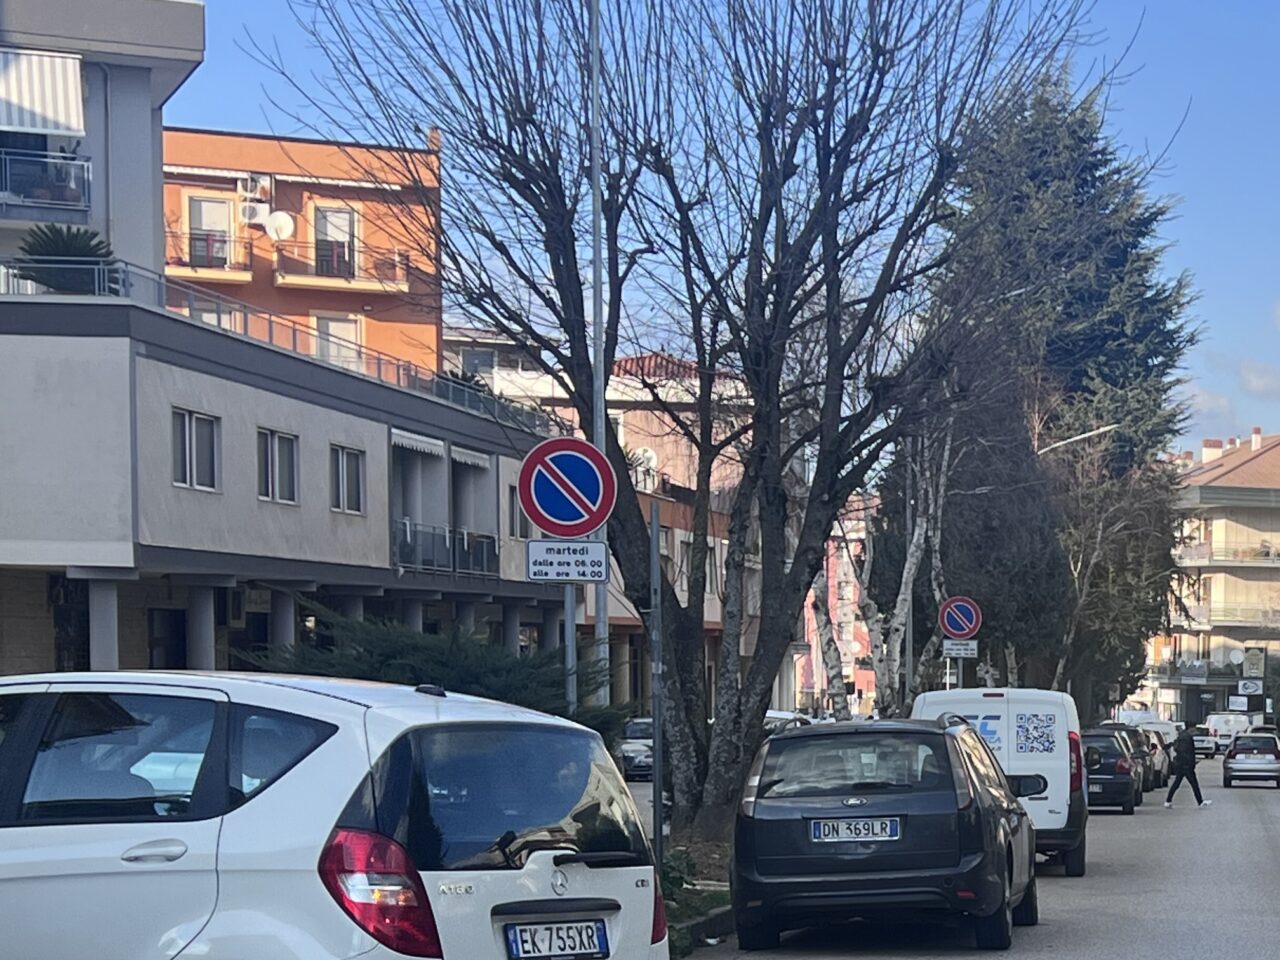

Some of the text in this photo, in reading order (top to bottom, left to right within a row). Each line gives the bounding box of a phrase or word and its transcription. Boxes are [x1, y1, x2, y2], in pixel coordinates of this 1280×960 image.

[532, 559, 554, 567] dalle
[822, 823, 839, 837] DN
[519, 925, 597, 954] EK 755XR
